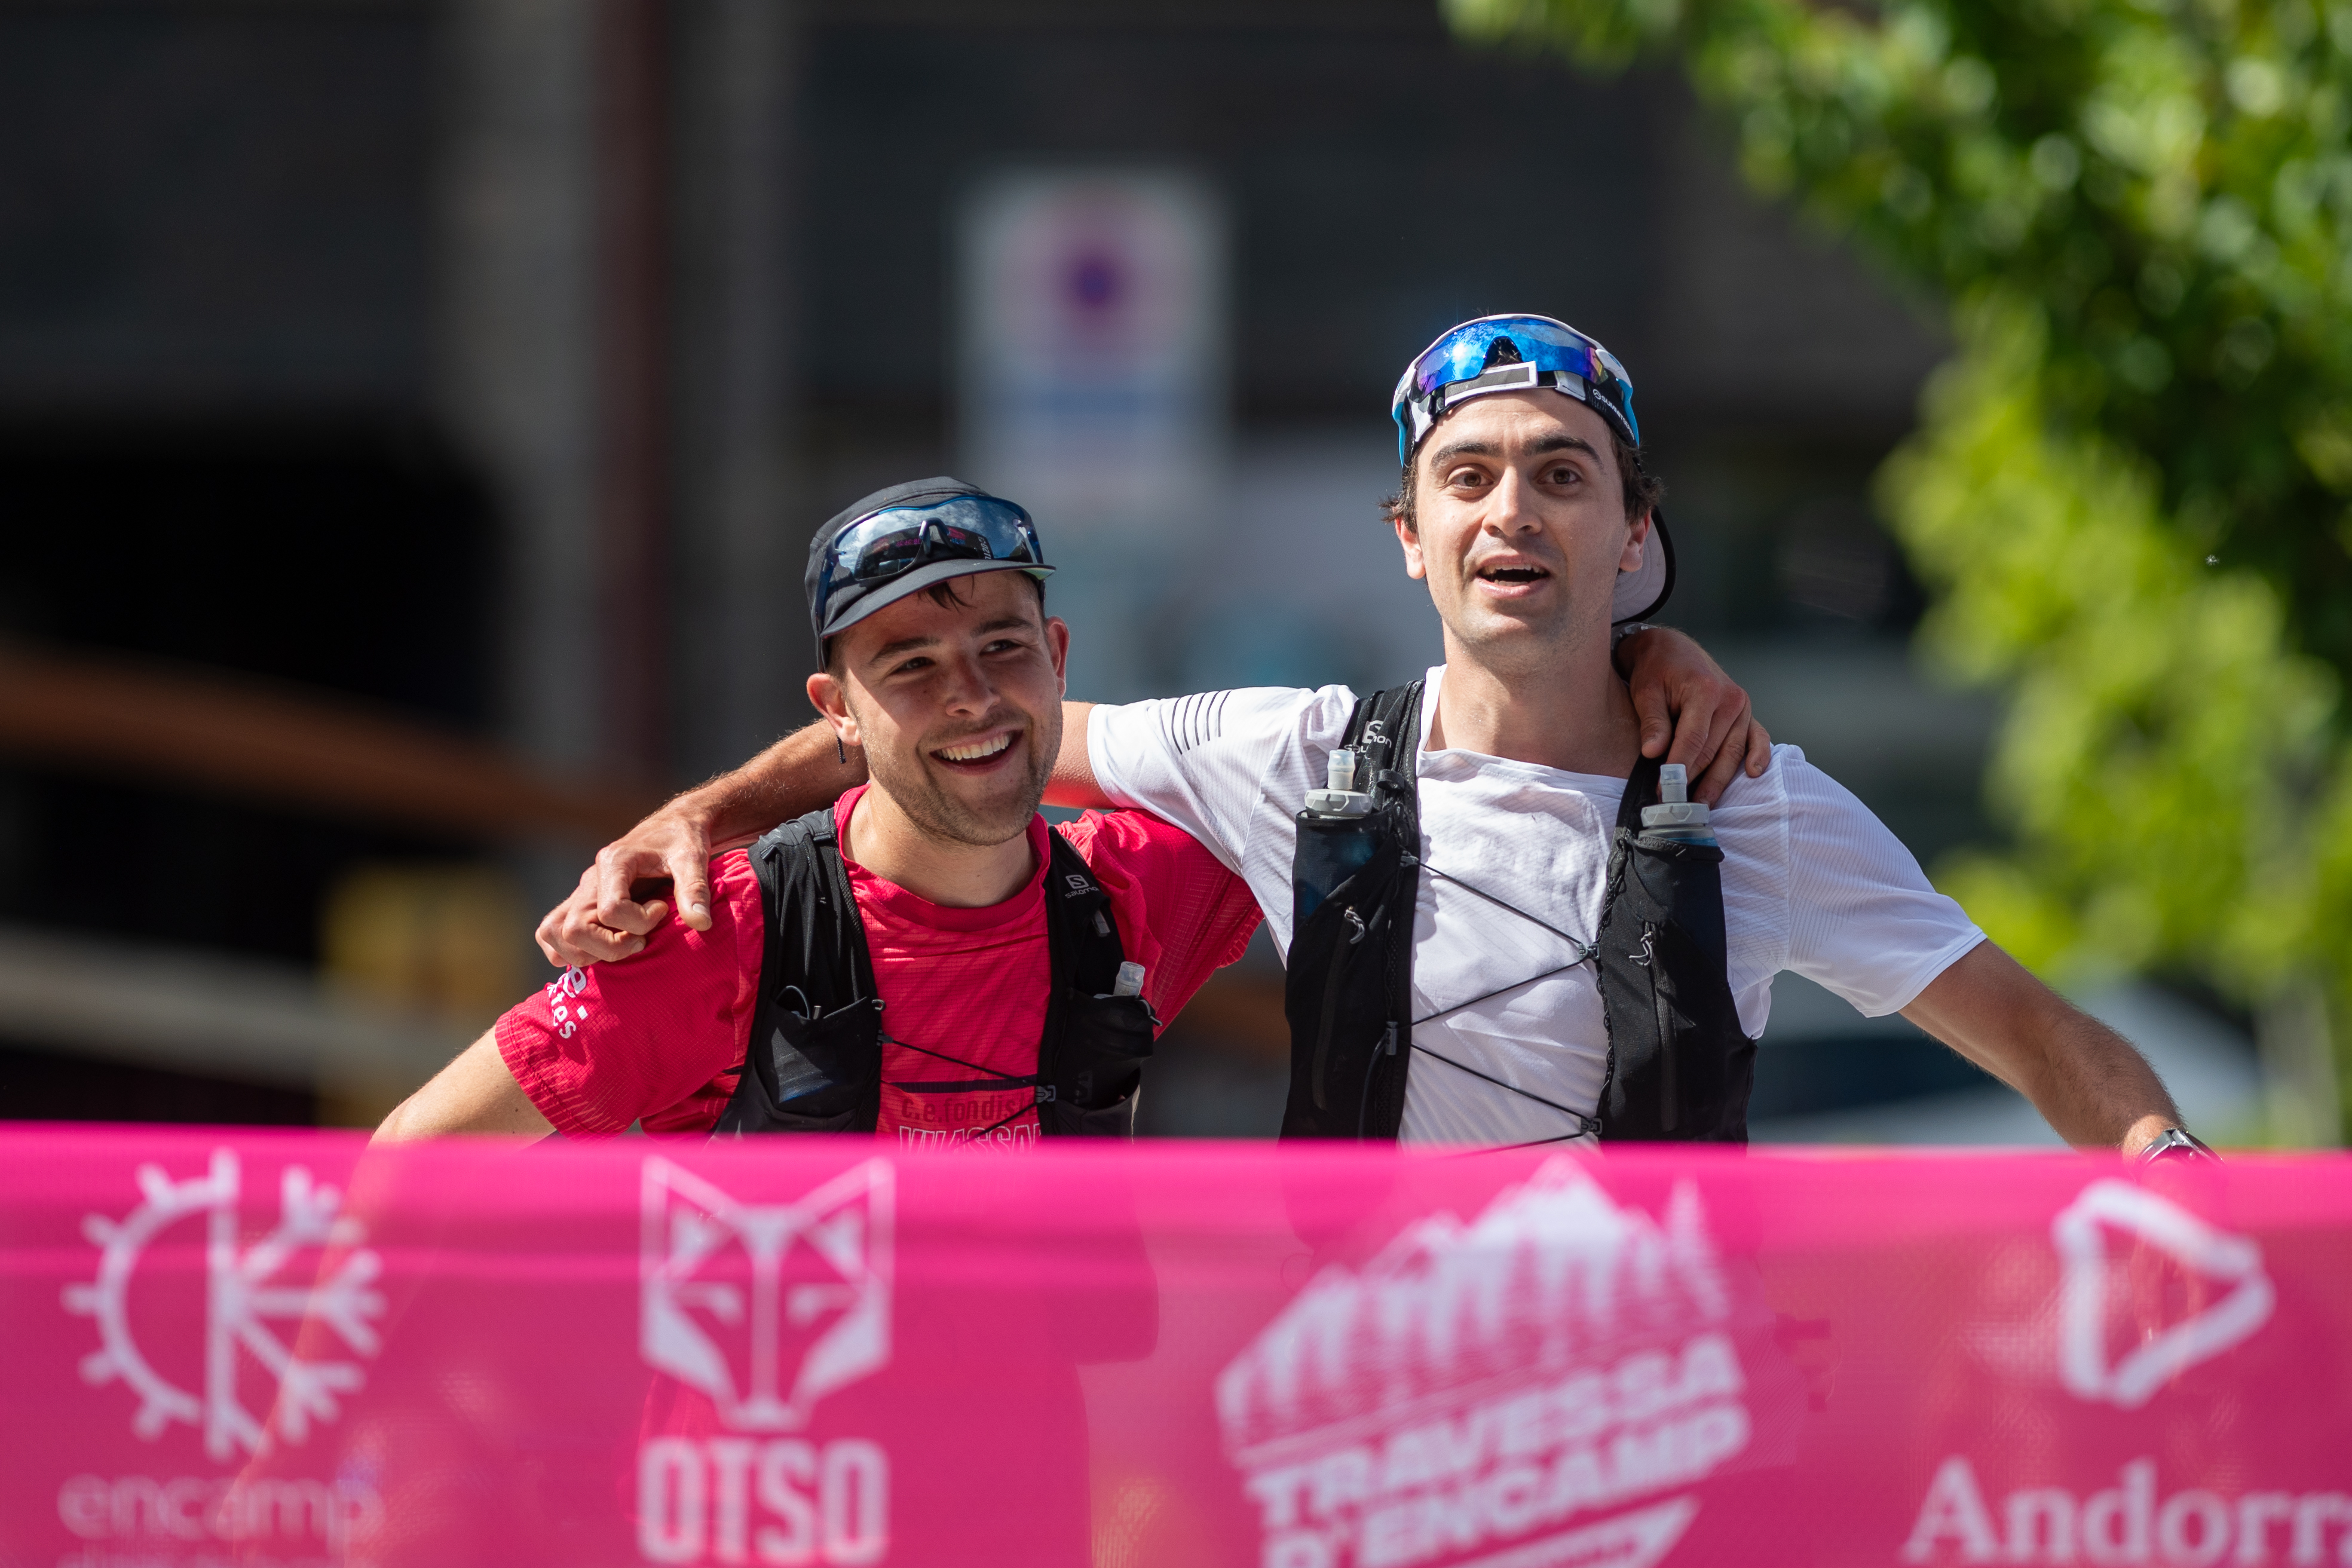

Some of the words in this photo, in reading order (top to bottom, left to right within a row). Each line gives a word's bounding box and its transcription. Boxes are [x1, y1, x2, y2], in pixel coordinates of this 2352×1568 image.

[1065, 886, 1100, 899] salomo
[1245, 1336, 1744, 1527] TRAVESSA
[57, 1473, 385, 1557] encamp
[638, 1438, 889, 1564] OTSO
[1905, 1456, 2352, 1567] Andorr
